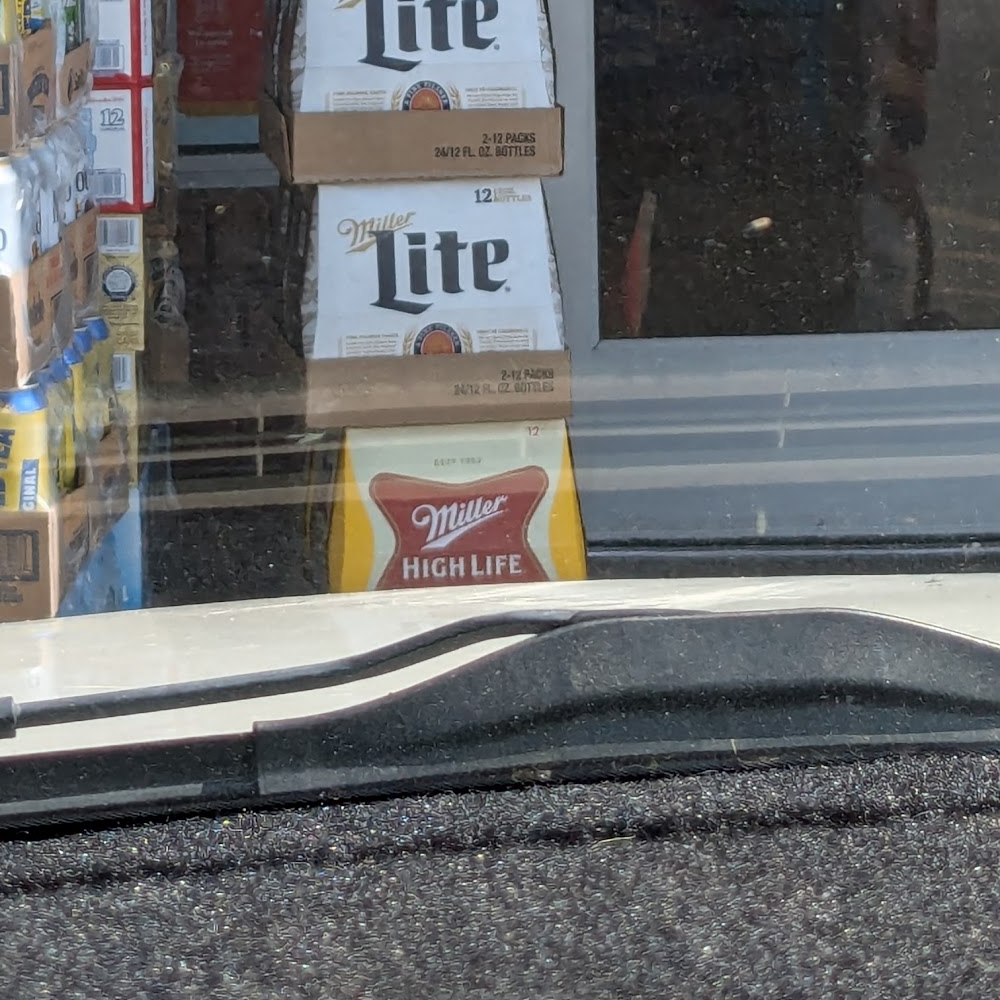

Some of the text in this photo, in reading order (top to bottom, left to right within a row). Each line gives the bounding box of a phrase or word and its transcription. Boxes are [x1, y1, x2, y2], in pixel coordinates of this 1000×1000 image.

[100, 107, 125, 126] 12
[482, 132, 536, 144] 2-12 PACKS
[495, 145, 536, 157] BOTTLES
[474, 188, 493, 203] 12
[337, 211, 416, 254] Miller
[369, 230, 510, 315] Lite
[501, 369, 522, 381] 2-12
[514, 381, 554, 393] BOTTLES
[527, 426, 540, 436] 12
[21, 466, 38, 511] GINAL
[411, 494, 509, 551] Miller
[402, 553, 523, 581] HIGH LIFE
